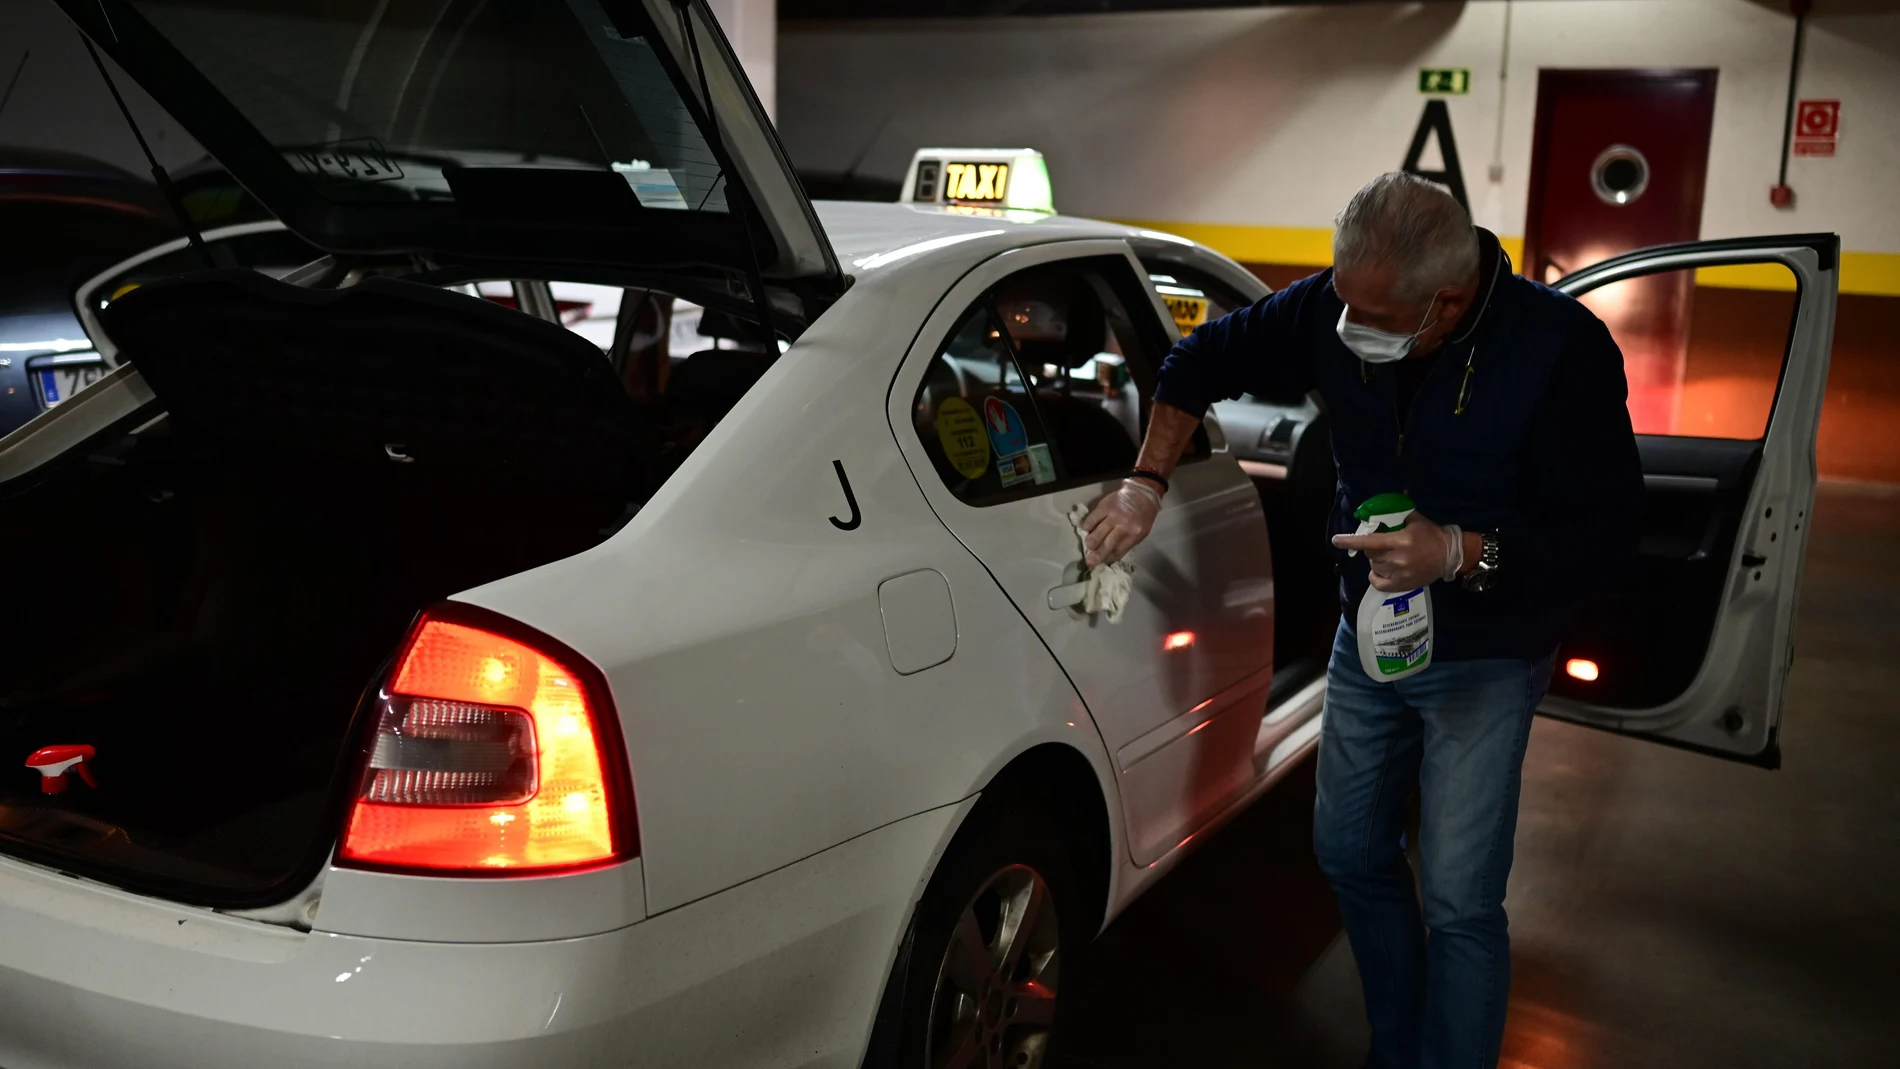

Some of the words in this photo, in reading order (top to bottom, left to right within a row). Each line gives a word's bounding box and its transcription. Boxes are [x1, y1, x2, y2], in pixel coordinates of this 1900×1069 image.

[946, 163, 1009, 200] TAXI
[1402, 99, 1472, 220] A
[957, 436, 975, 448] 112
[828, 459, 861, 531] J
